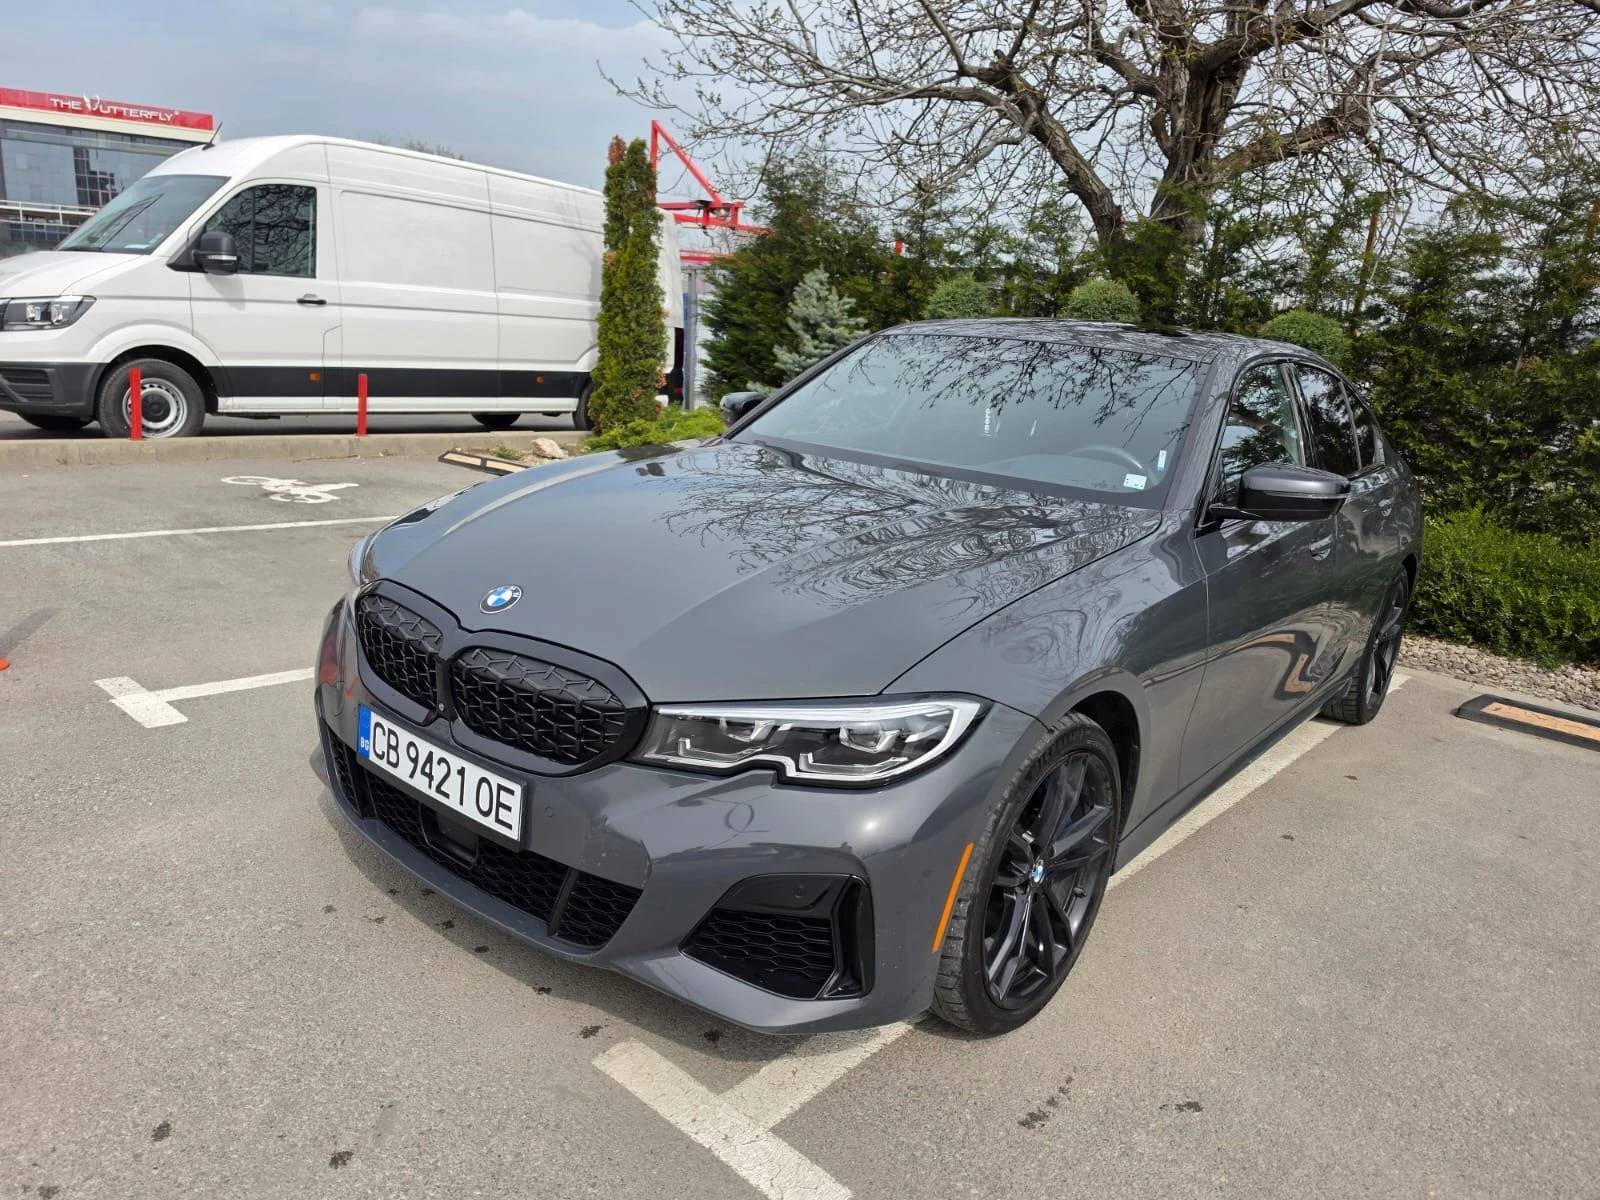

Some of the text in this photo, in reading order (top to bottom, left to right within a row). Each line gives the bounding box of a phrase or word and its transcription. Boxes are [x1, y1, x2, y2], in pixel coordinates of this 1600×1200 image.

[50, 97, 82, 110] THE
[360, 736, 370, 751] BG
[372, 721, 516, 831] CB 9421 OE
